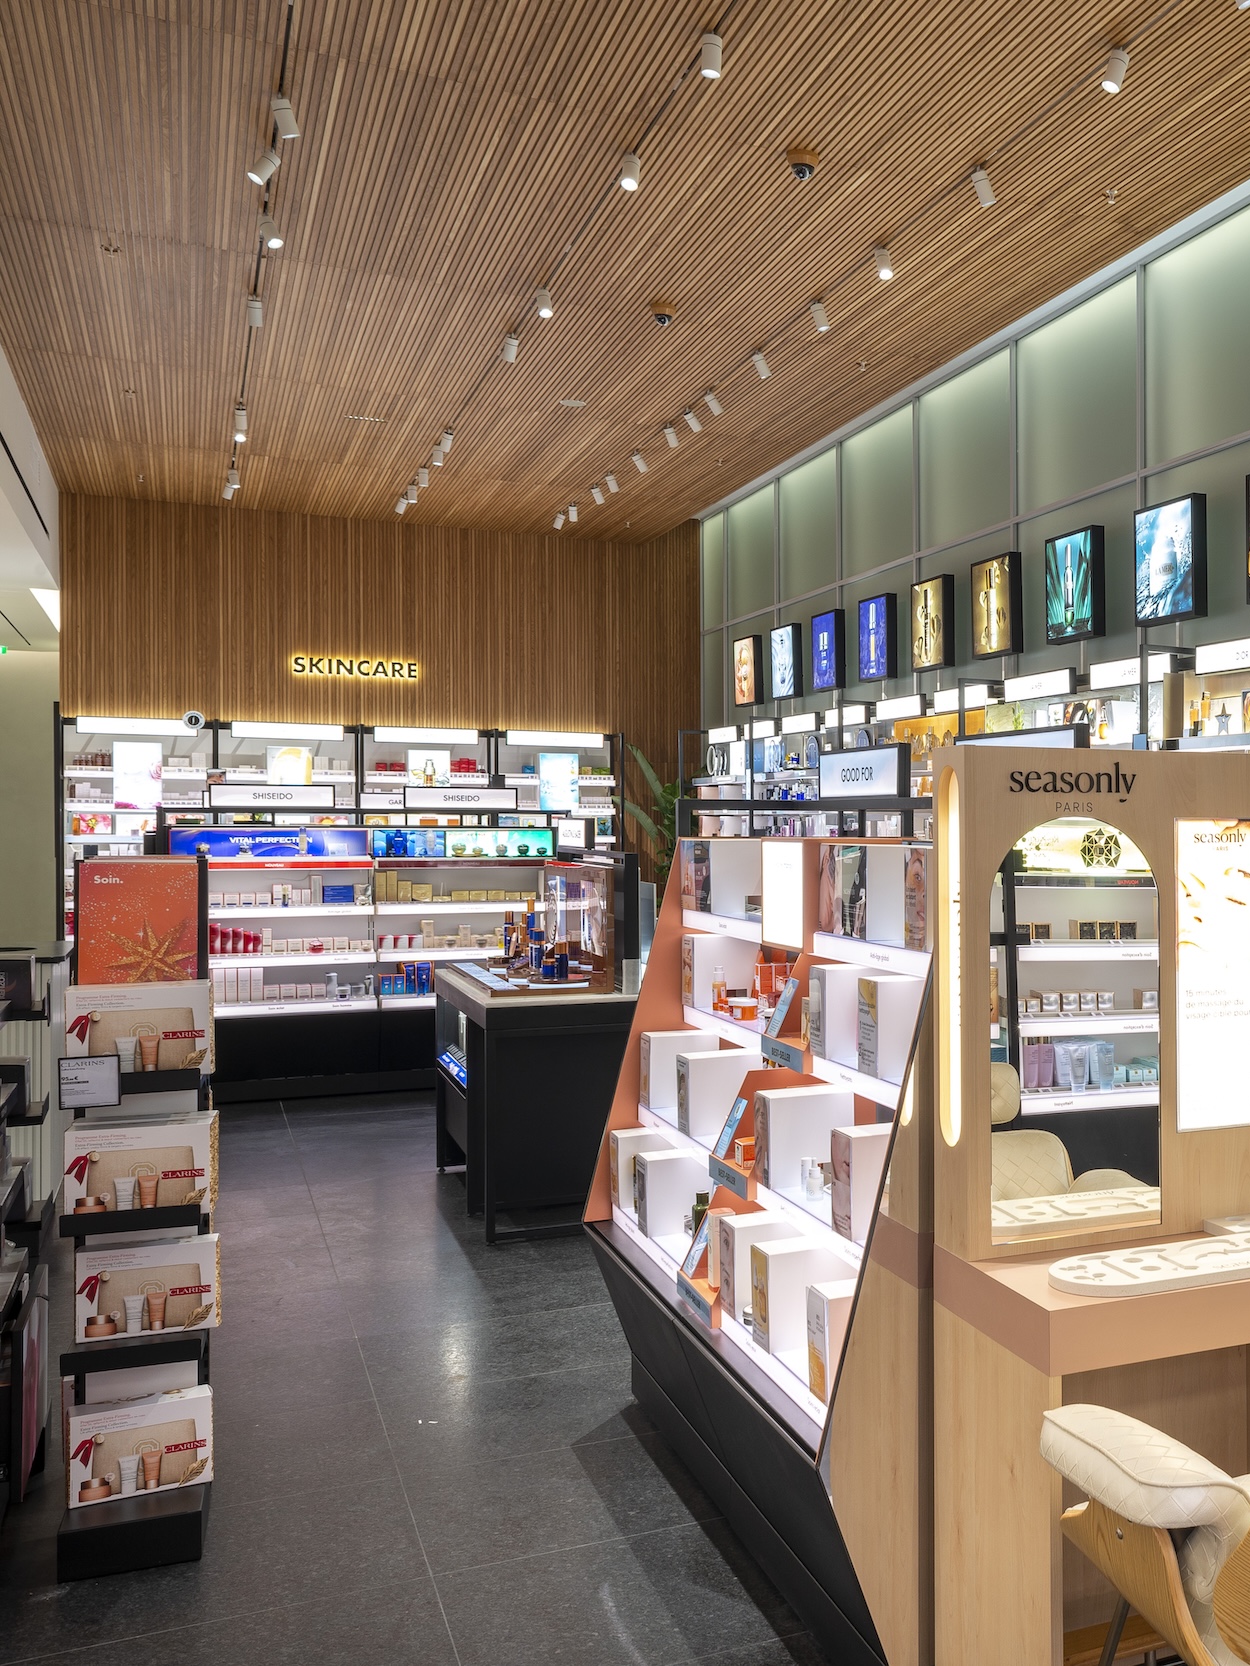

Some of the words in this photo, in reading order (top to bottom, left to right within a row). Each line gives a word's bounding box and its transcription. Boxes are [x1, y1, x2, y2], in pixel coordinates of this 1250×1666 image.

[293, 656, 418, 679] SKINCARE
[841, 768, 860, 782] GOOD
[861, 767, 874, 781] FOR
[1009, 761, 1137, 803] seasonly
[252, 792, 293, 800] SHISEIDO
[443, 794, 480, 802] SHISEIDO
[1055, 802, 1093, 813] PARIS
[229, 836, 254, 844] VITAL
[255, 836, 312, 844] PERFECTIN
[1193, 828, 1247, 847] seasonly
[94, 875, 124, 884] Soin.
[163, 1030, 204, 1039] CLARINS
[61, 1060, 105, 1068] CLARINS
[162, 1169, 204, 1179] CLARINS
[170, 1285, 211, 1296] CLARINS
[165, 1439, 206, 1453] CLARINS
